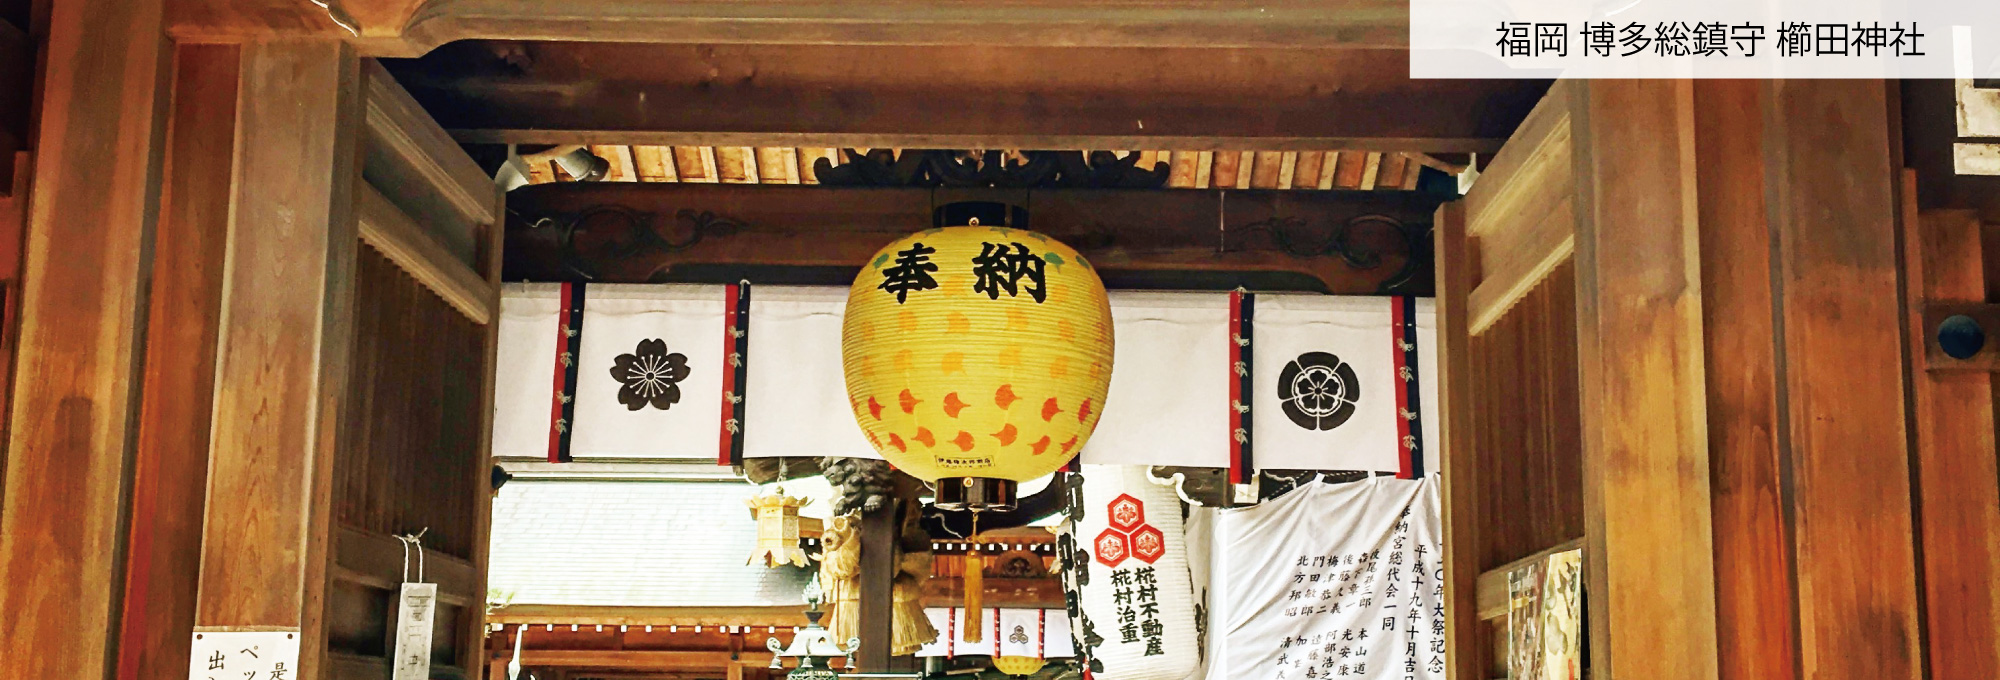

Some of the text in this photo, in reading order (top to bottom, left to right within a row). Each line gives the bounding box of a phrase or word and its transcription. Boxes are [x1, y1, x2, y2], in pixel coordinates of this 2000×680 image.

[877, 241, 1047, 304] 奉納
[1110, 568, 1141, 644] 椛村治重
[1134, 566, 1165, 656] 椛村不動産
[208, 650, 225, 680] 出
